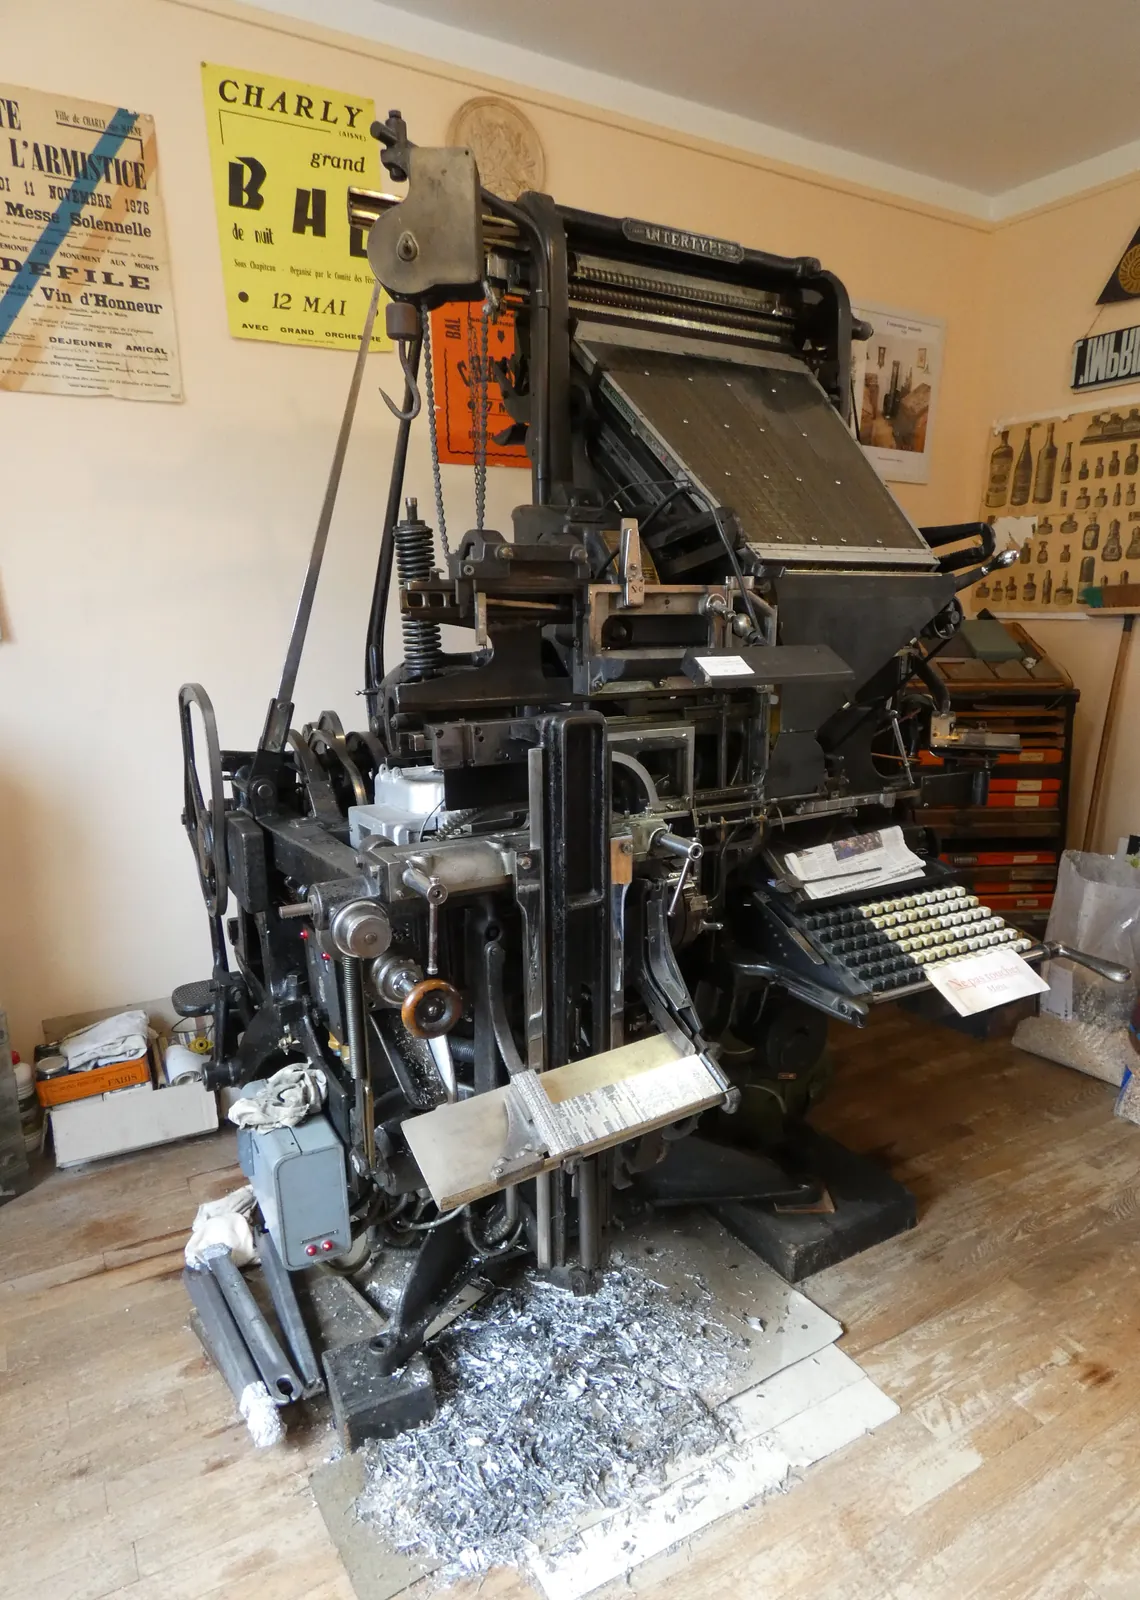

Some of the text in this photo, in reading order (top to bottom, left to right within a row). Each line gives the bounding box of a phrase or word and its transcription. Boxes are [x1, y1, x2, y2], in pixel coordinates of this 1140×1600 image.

[218, 79, 363, 128] CHARLY
[55, 110, 69, 122] Ville
[73, 114, 80, 124] de
[83, 116, 106, 130] CHARLY
[9, 137, 147, 190] L'ARMISTICE
[310, 152, 365, 174] grand
[24, 180, 35, 197] 11
[48, 184, 112, 209] NOVEMBRE
[125, 198, 149, 215] 1976
[5, 200, 152, 238] Messe Solennelle
[232, 223, 274, 245] de nuit
[644, 226, 727, 256] INTERTYPE
[0, 257, 150, 291] DEFILE
[59, 251, 101, 264] MONUMENT
[110, 258, 126, 267] AUX
[134, 262, 159, 272] MORTS
[40, 286, 72, 304] Vin
[80, 292, 163, 315] d'Honneur
[272, 292, 347, 317] 12 MAI
[242, 323, 269, 331] AVEC
[280, 326, 314, 336] GRAND
[325, 331, 381, 342] ORCHESRE
[444, 318, 461, 340] BAL
[49, 336, 113, 349] DEJEUNER
[126, 345, 168, 355] AMICAL
